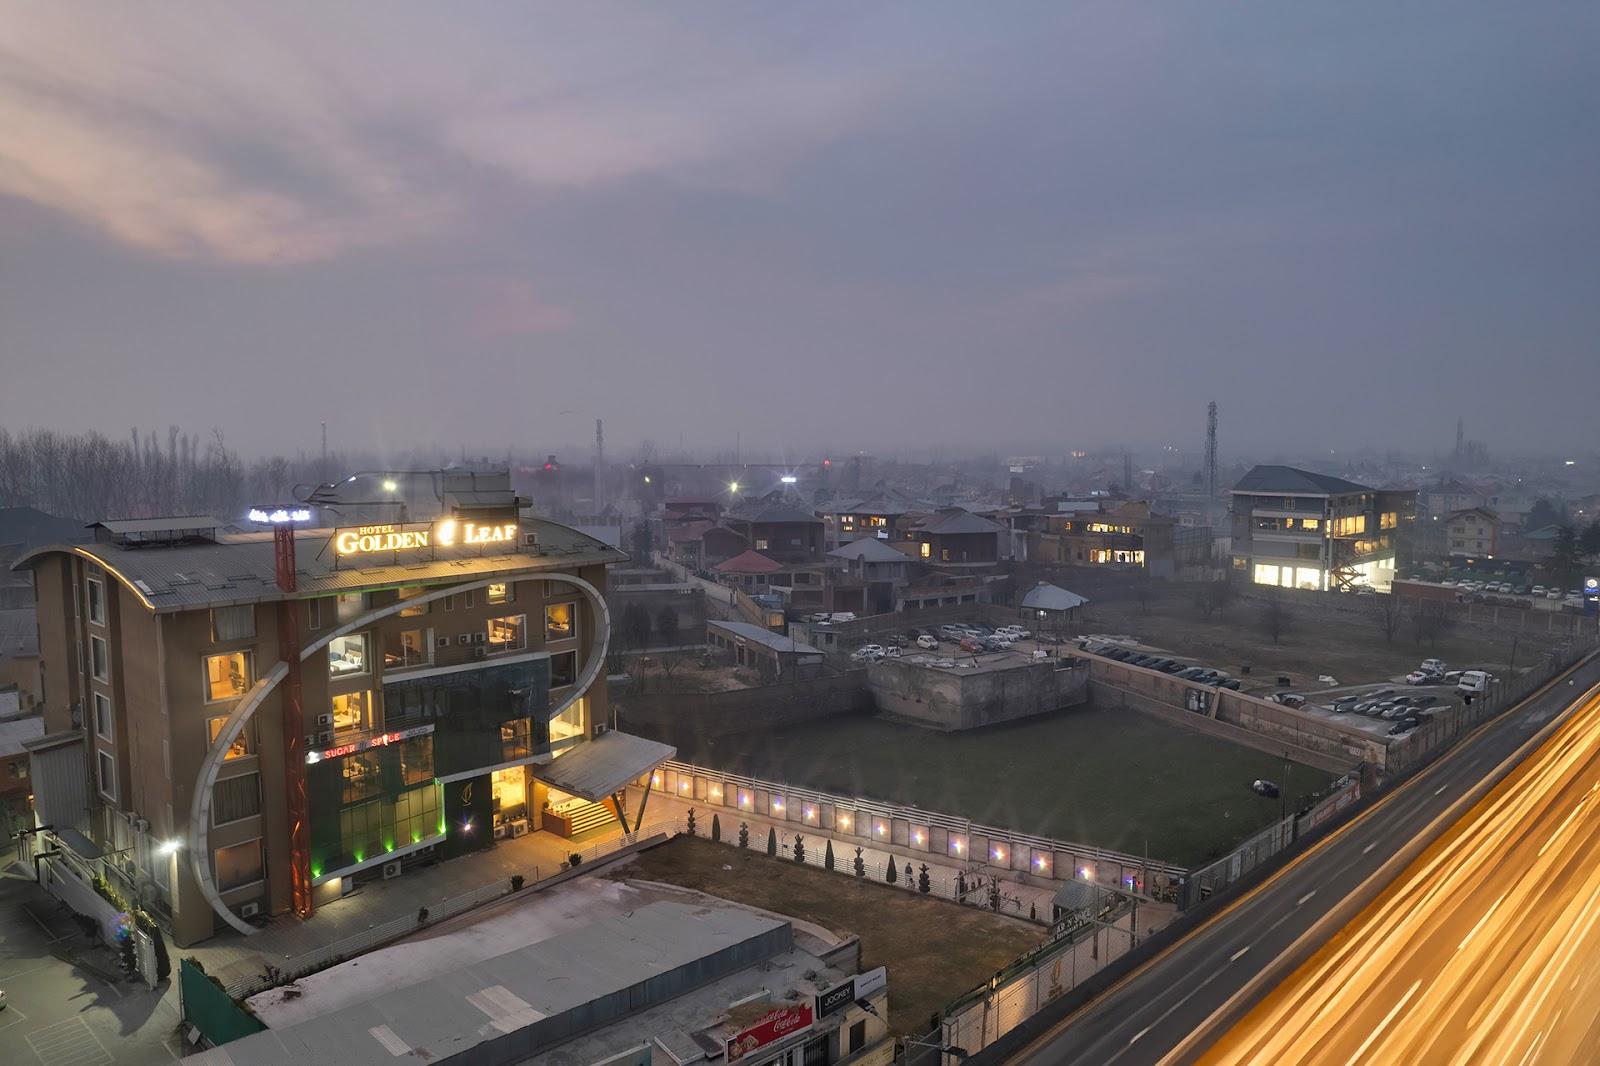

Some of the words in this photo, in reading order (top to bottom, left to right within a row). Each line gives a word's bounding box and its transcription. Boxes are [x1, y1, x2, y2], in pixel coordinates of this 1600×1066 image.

[337, 531, 429, 554] GOLDEN
[464, 523, 517, 544] LEAF
[360, 525, 394, 535] HOTEL
[325, 744, 355, 760] SUGAR
[824, 986, 851, 1007] JOCKEY
